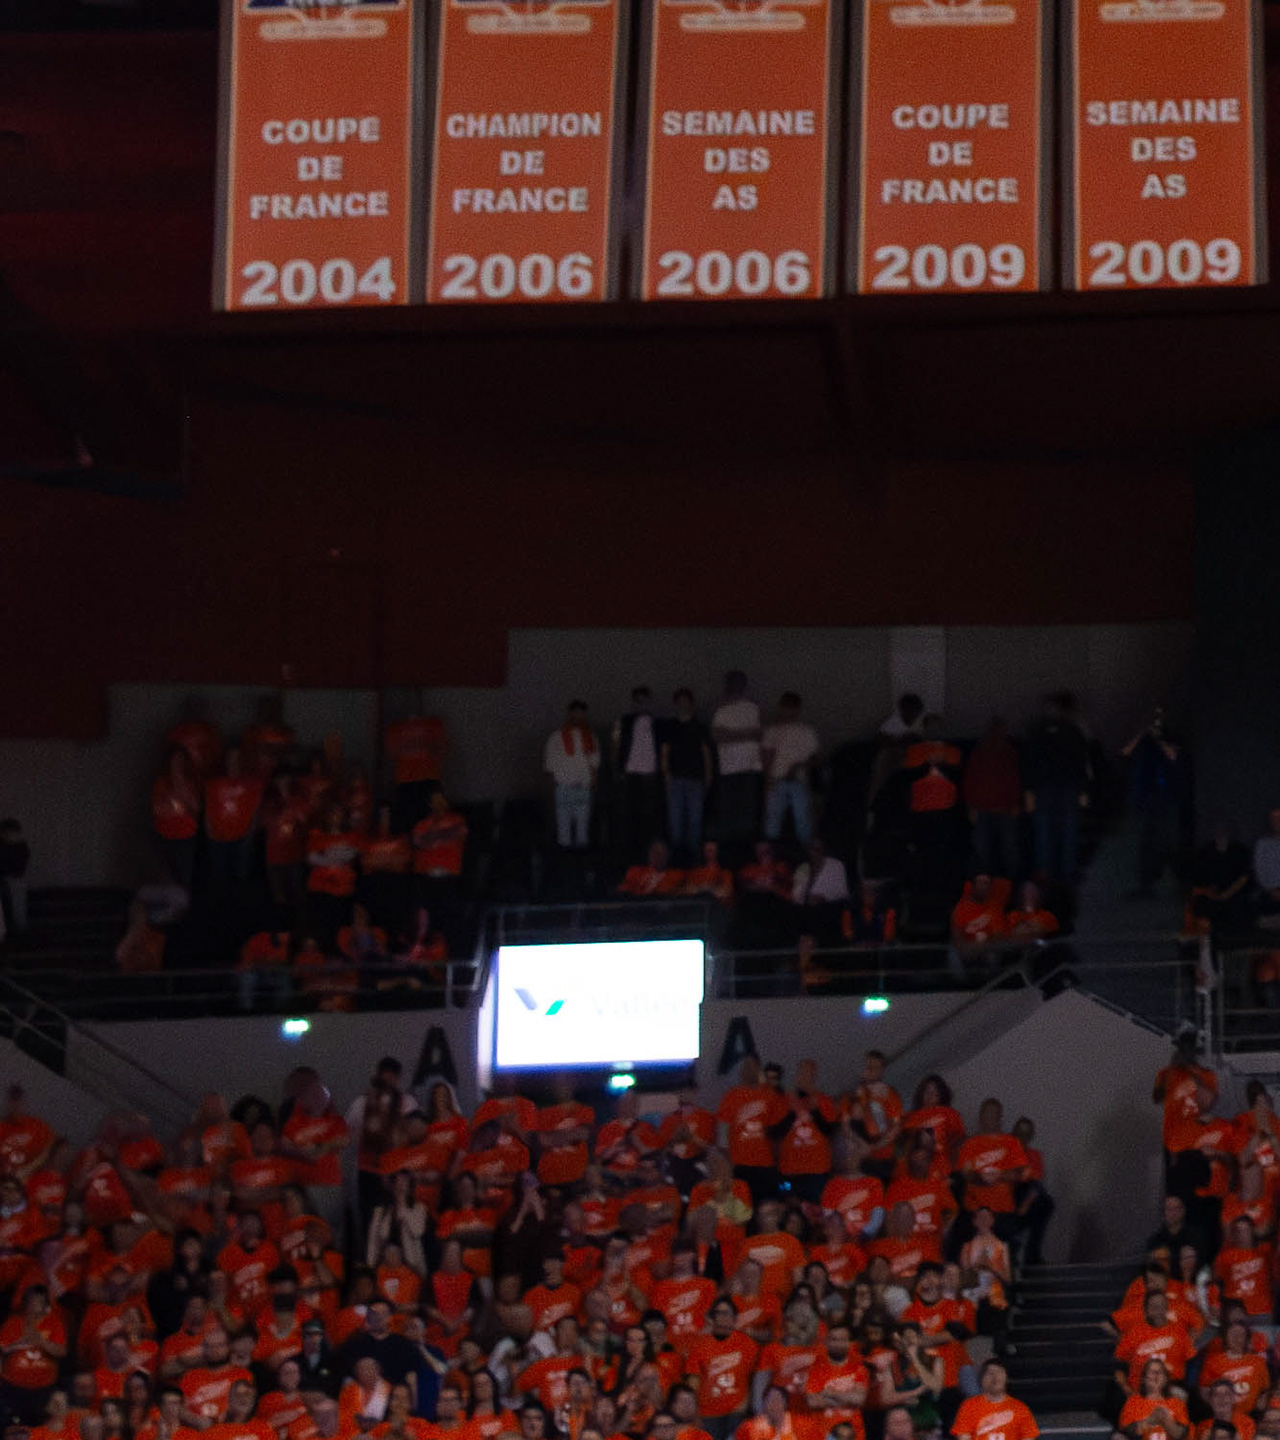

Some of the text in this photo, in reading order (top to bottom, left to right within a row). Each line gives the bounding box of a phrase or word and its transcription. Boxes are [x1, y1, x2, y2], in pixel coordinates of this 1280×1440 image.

[662, 110, 815, 136] SEMAINE
[892, 103, 1009, 130] COUPE
[1086, 98, 1240, 125] SEMAINE
[262, 117, 380, 145] COUPE
[447, 112, 601, 138] CHAMPION
[704, 148, 771, 173] DES
[928, 141, 973, 166] DE
[1131, 137, 1198, 163] DES
[298, 156, 343, 181] DE
[500, 151, 545, 176] DE
[712, 185, 759, 210] AS
[881, 178, 1018, 204] FRANCE
[1141, 174, 1187, 199] AS
[250, 192, 388, 220] FRANCE
[452, 188, 589, 213] FRANCE
[658, 250, 810, 297] 2006
[872, 243, 1026, 289] 2009
[1089, 238, 1242, 286] 2009
[240, 257, 395, 307] 2004
[441, 253, 594, 299] 2006
